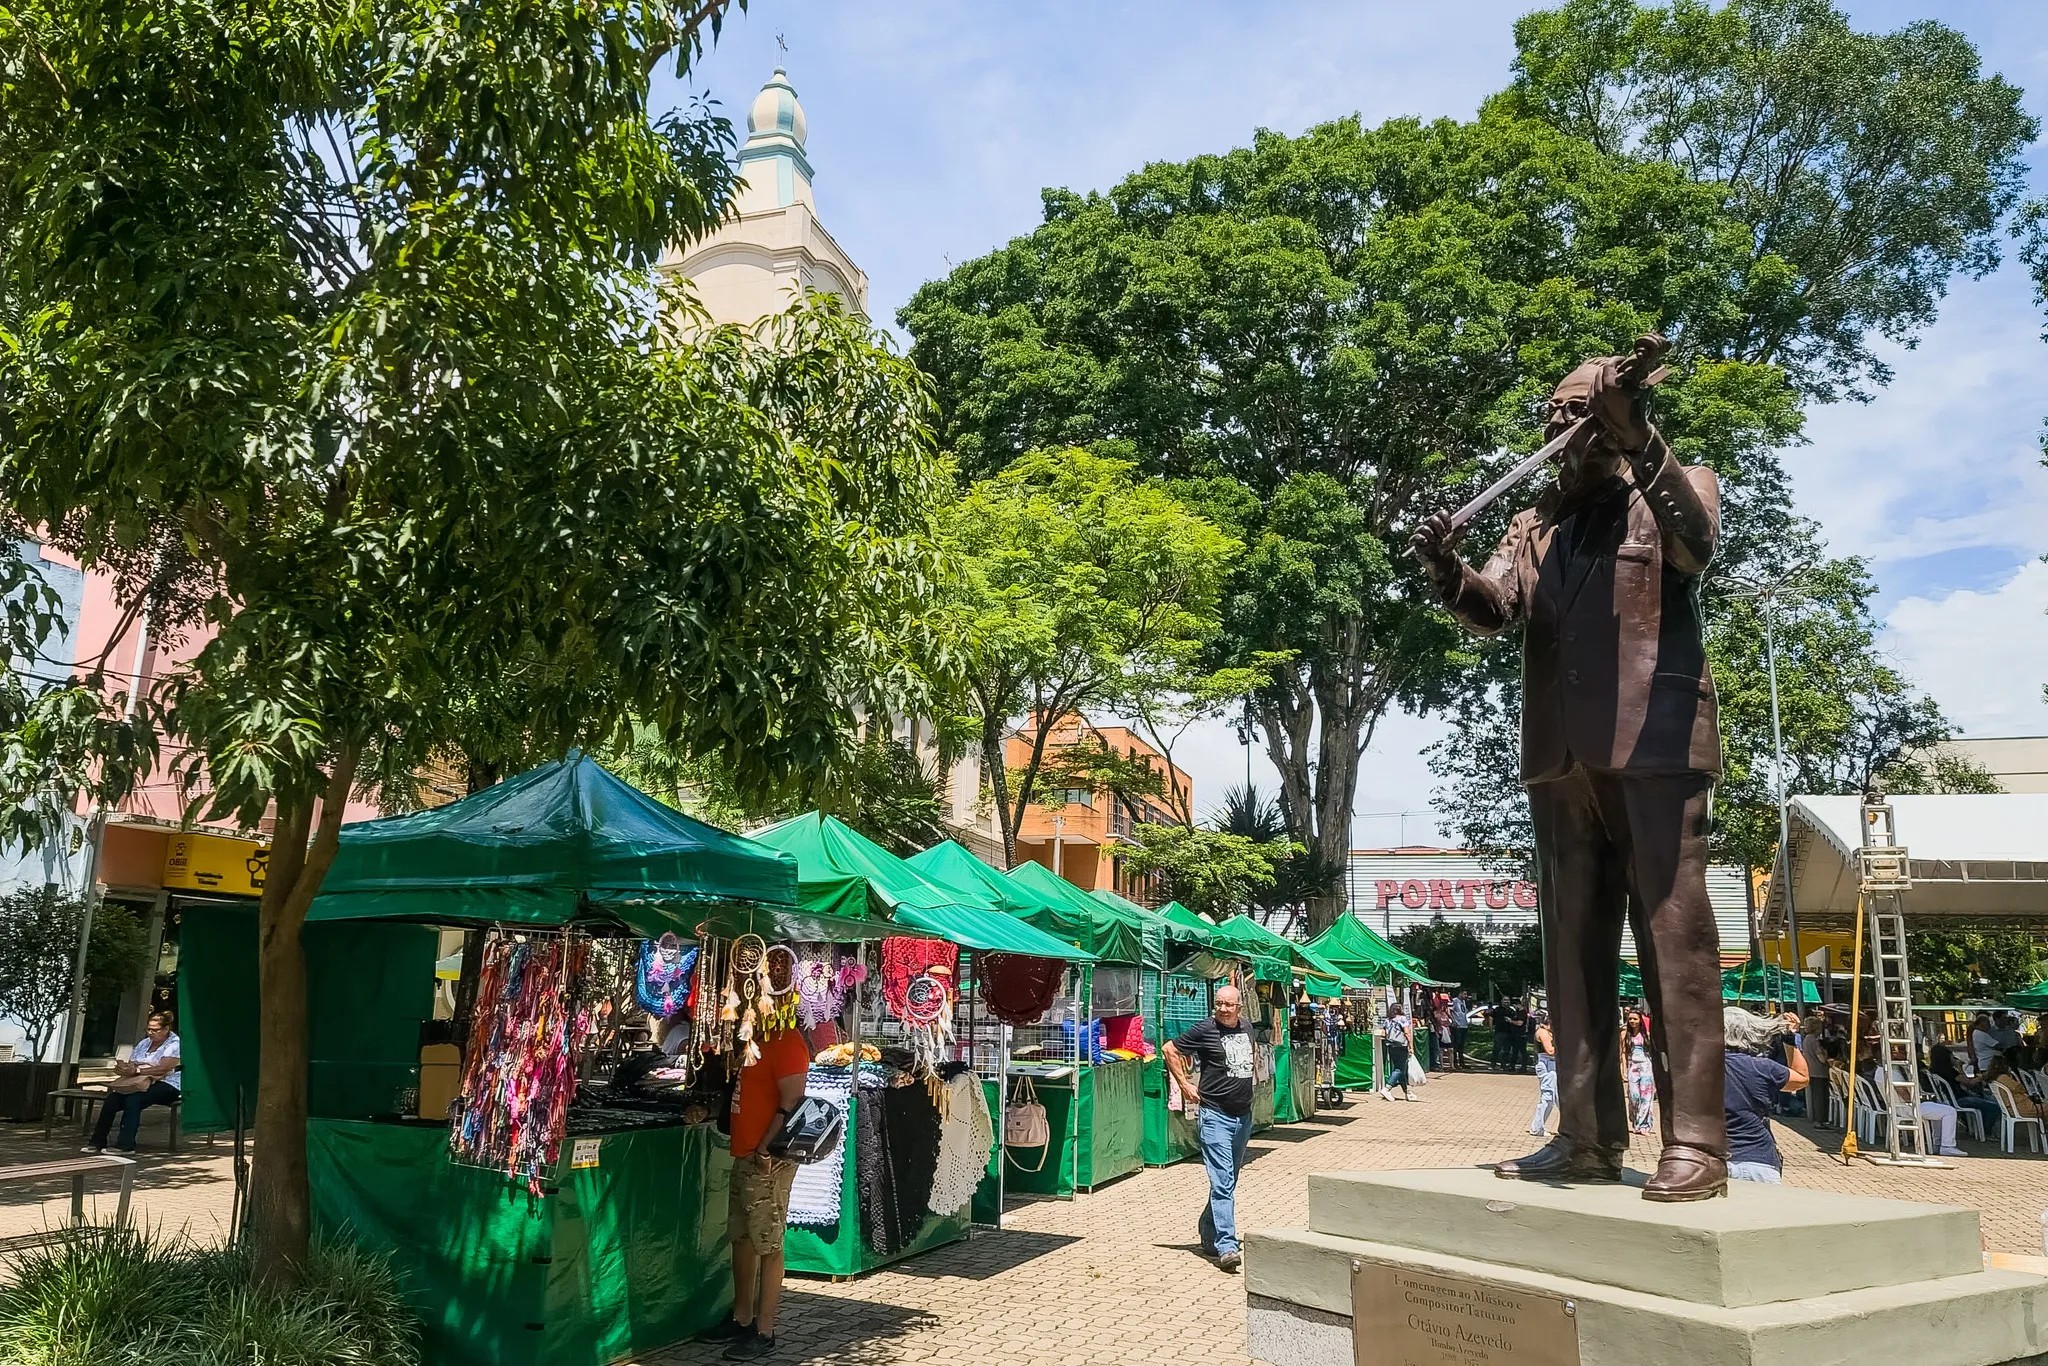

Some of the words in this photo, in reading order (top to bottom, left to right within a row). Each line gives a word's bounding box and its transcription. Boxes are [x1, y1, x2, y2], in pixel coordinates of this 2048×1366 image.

[1404, 1290, 1465, 1314] Compositor
[1465, 1302, 1516, 1325] Tatuiano
[1458, 1291, 1471, 1300] ao
[1473, 1289, 1514, 1309] Músico
[1407, 1313, 1451, 1337] Otávio
[1455, 1324, 1512, 1352] Azevedo
[1455, 1343, 1489, 1360] Azevedo
